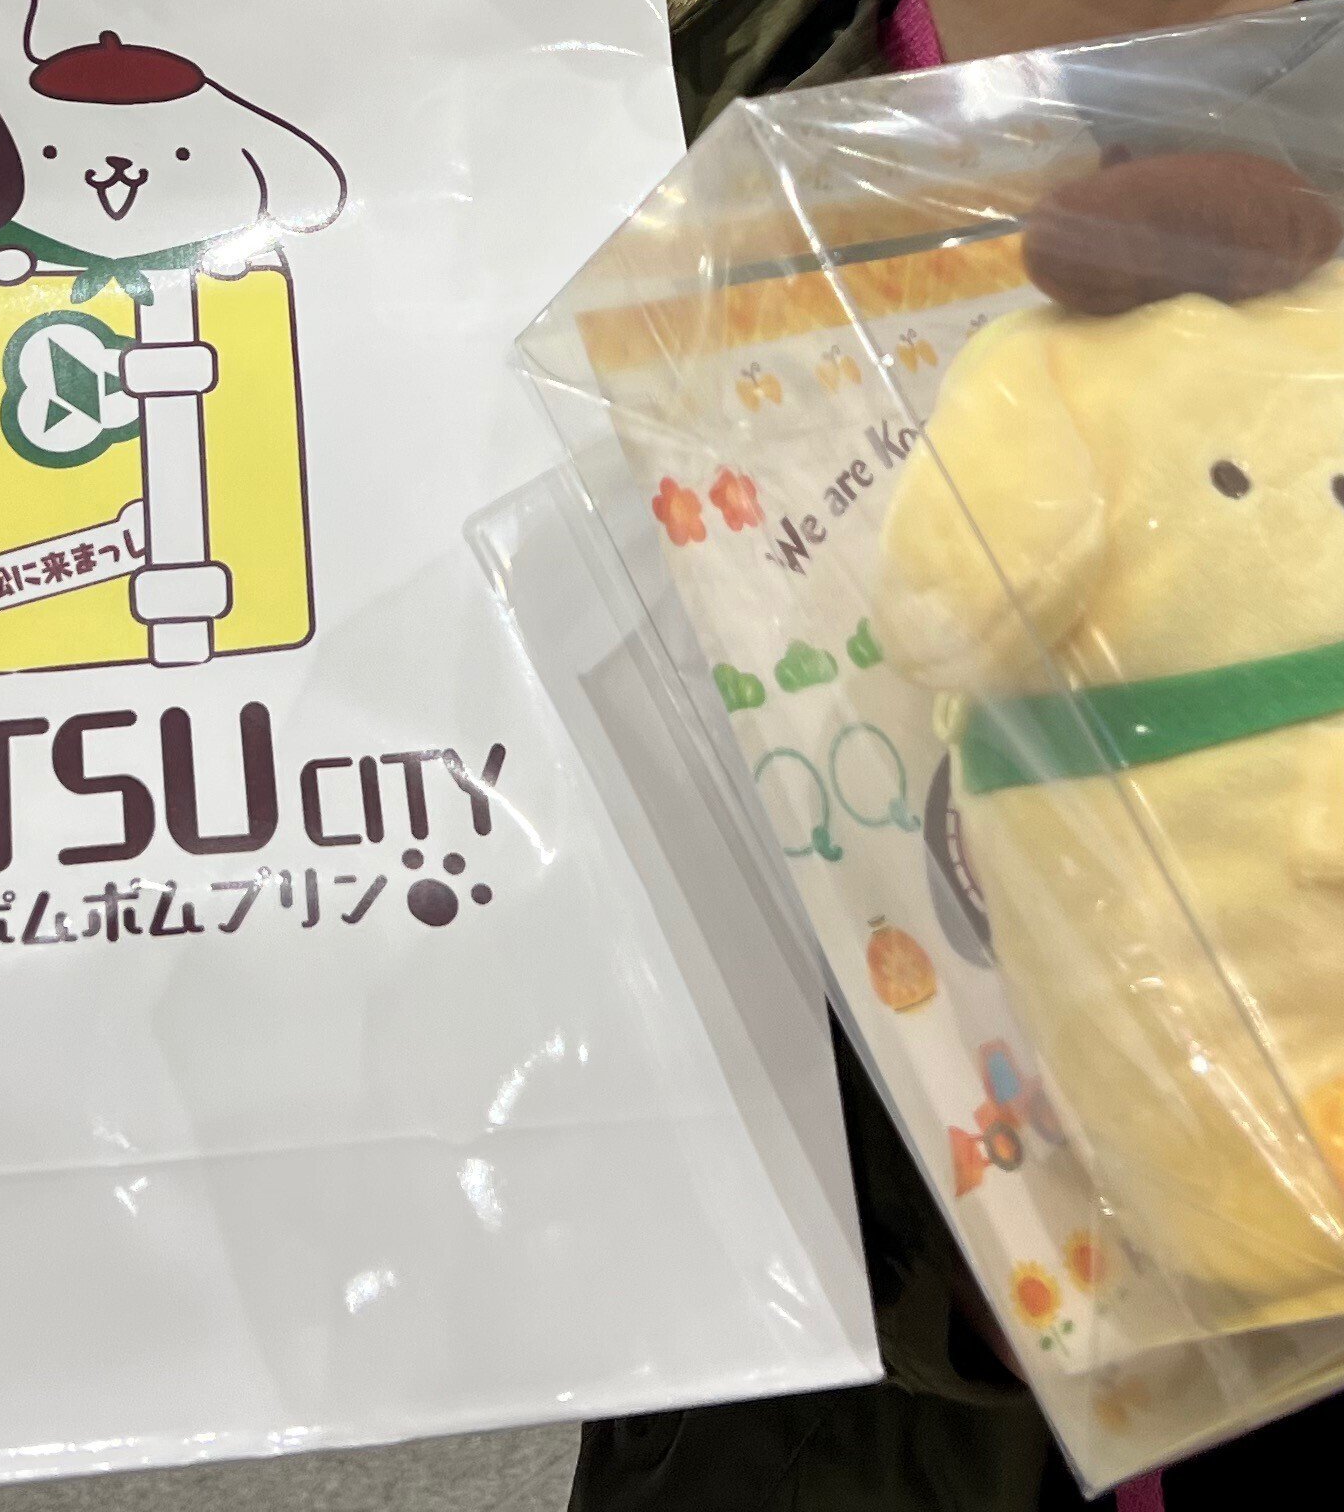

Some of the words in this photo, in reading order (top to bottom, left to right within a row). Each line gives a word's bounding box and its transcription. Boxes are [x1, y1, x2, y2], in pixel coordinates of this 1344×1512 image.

[764, 514, 827, 576] We
[823, 459, 874, 517] are
[299, 742, 507, 847] CITY
